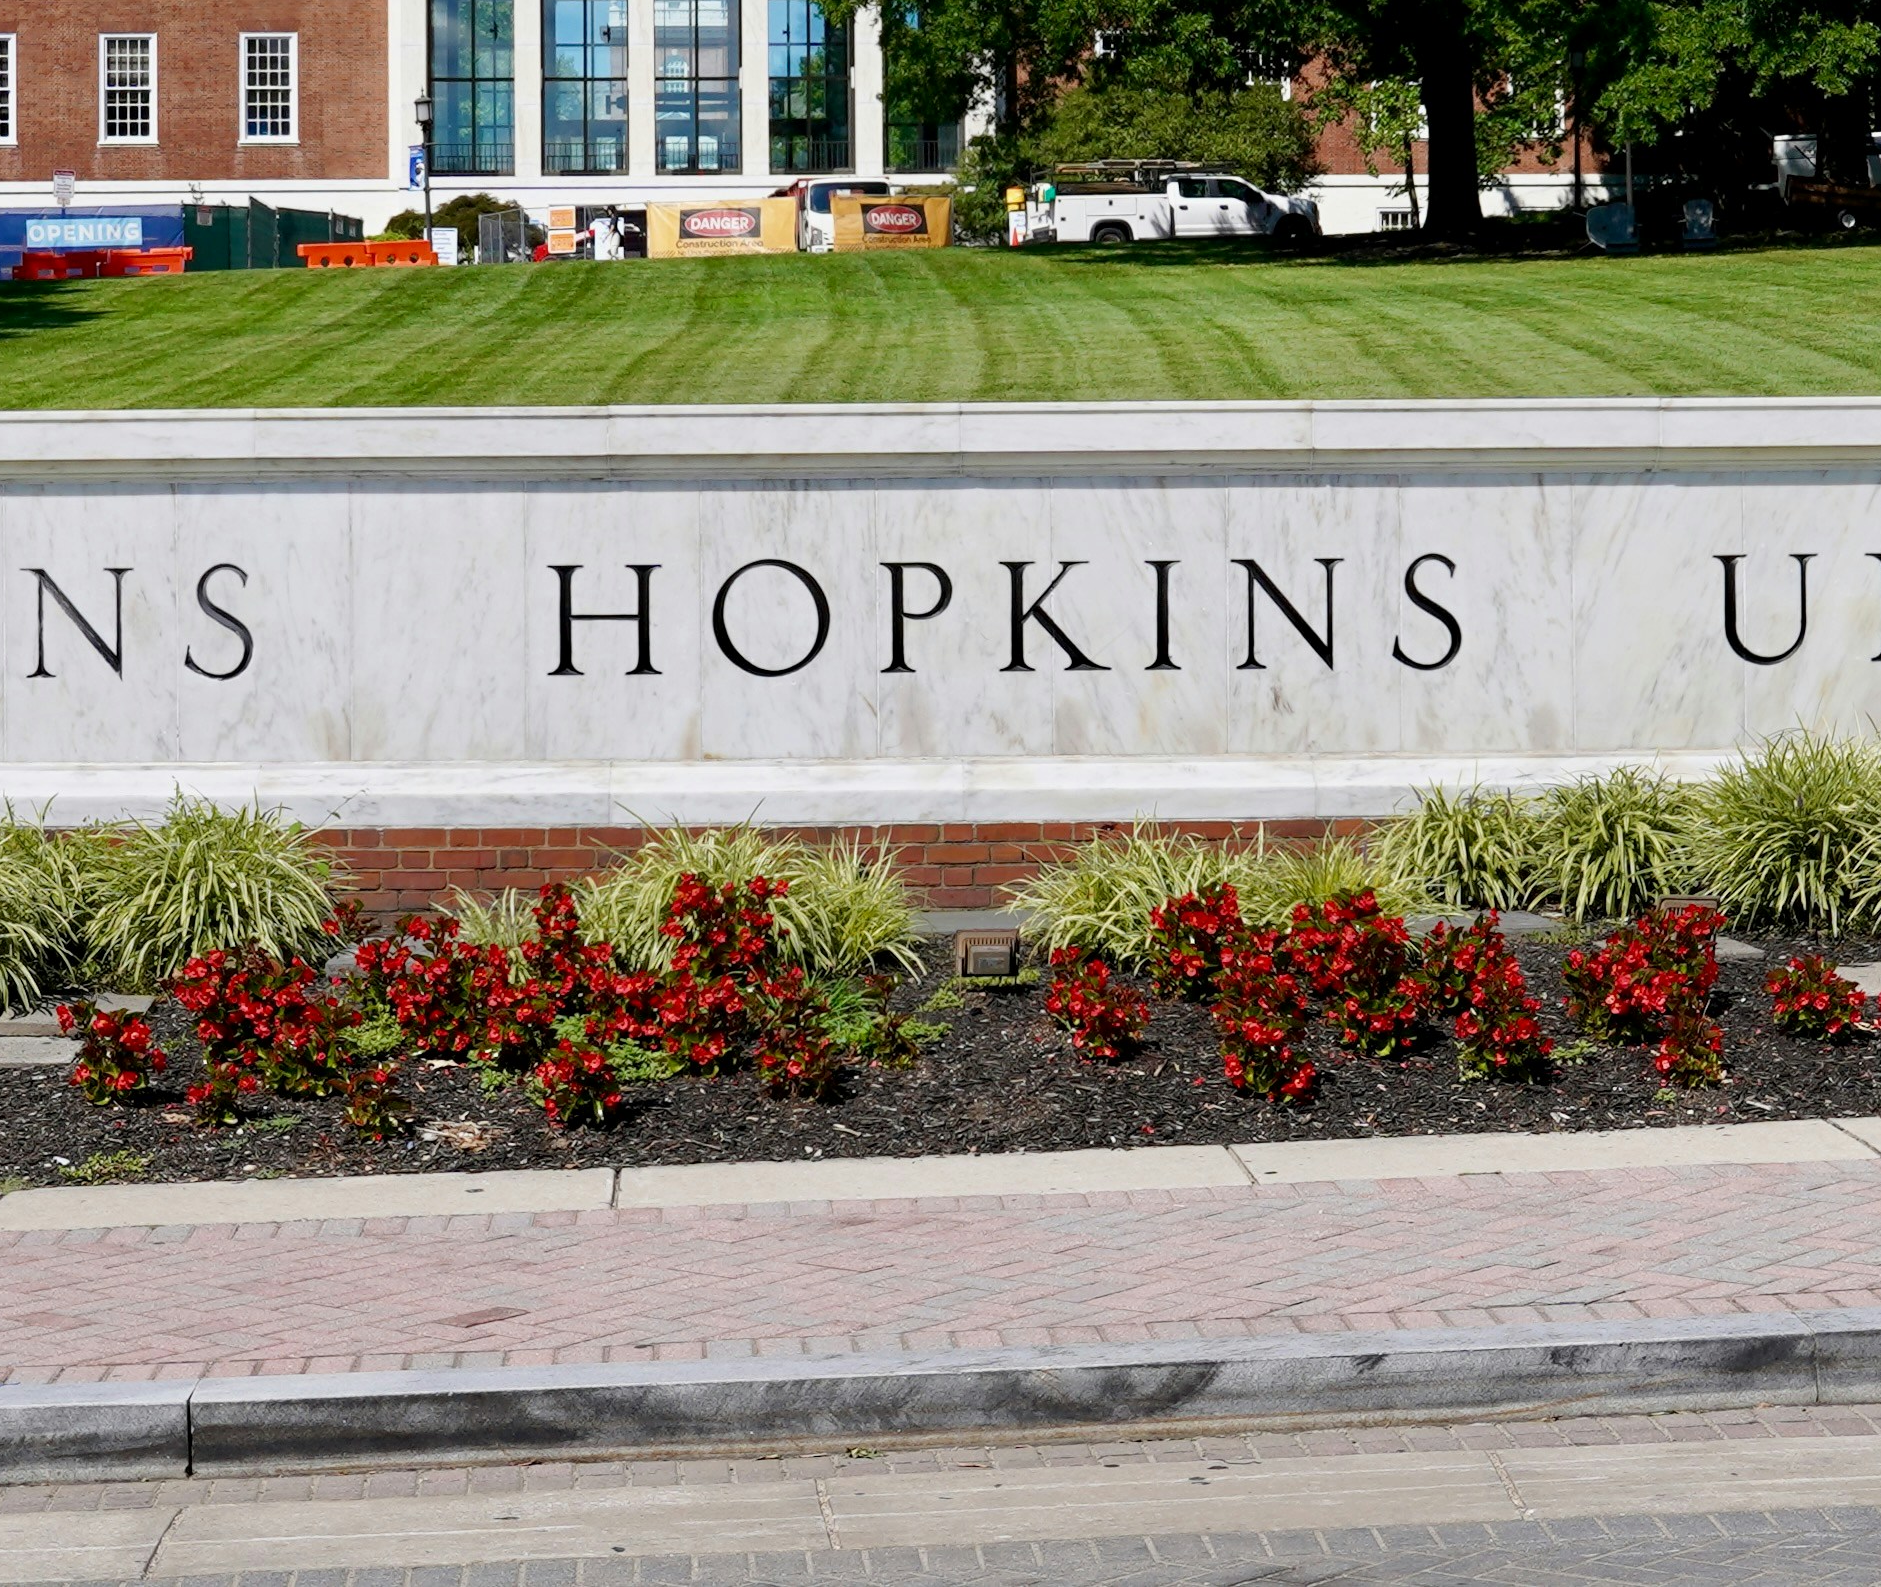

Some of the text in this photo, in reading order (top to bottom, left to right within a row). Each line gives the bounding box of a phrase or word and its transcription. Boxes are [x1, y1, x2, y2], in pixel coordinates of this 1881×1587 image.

[690, 216, 749, 231] DANGER
[871, 212, 917, 226] DANGER
[29, 222, 140, 243] OPENING
[675, 237, 764, 249] Construction Area
[547, 553, 1462, 677] HOPKINS
